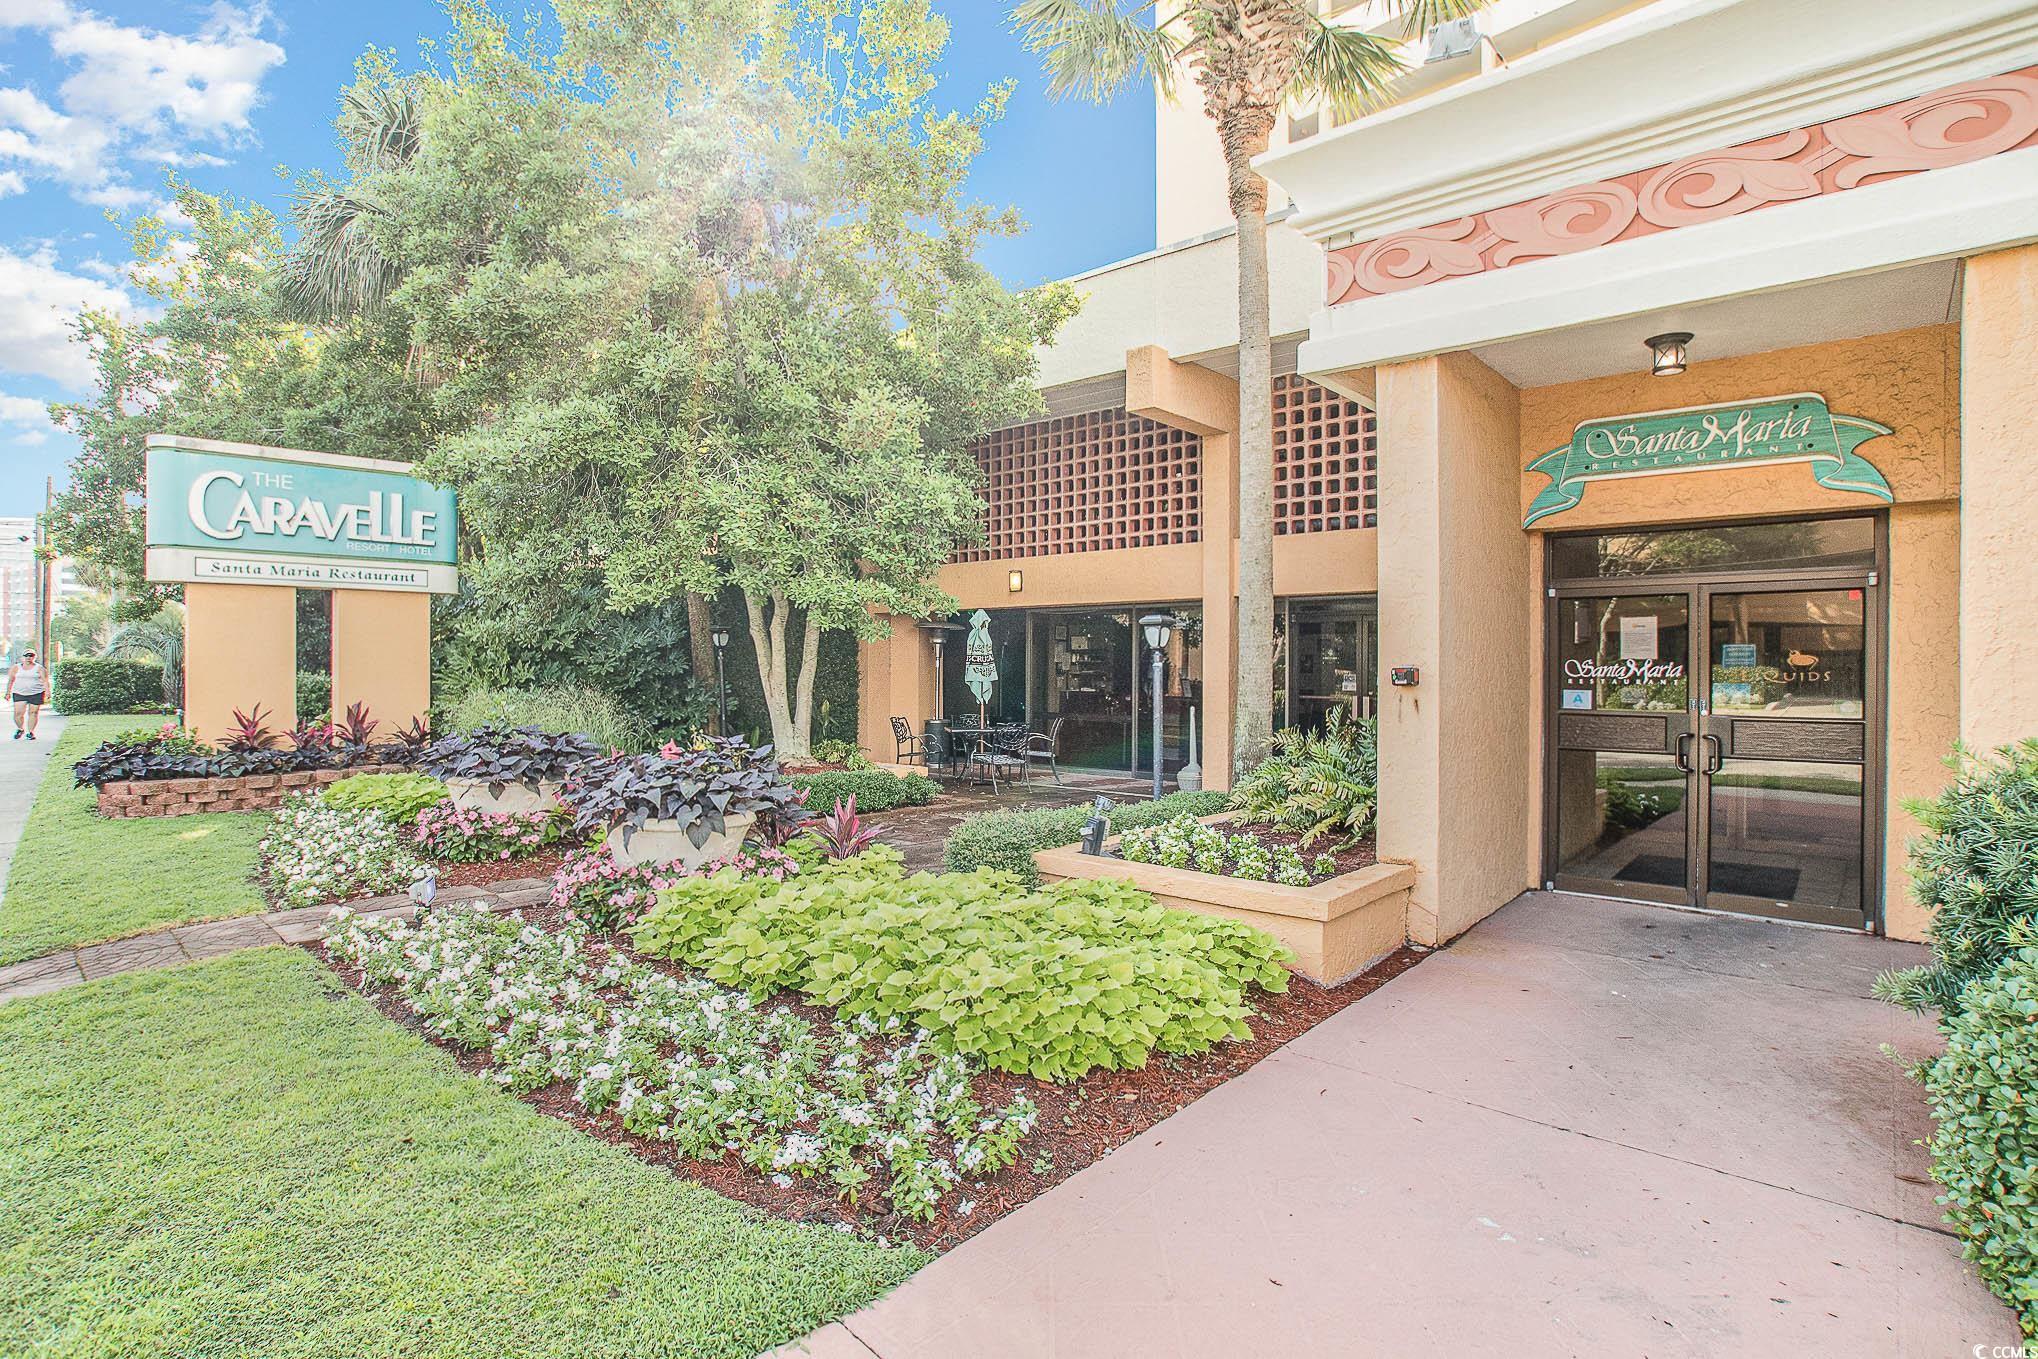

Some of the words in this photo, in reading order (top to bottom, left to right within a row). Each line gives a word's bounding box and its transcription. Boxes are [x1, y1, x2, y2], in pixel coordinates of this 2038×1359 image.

[1585, 424, 1697, 460] Santa
[1692, 411, 1813, 456] Maria
[1591, 442, 1804, 470] RESTAURANT
[252, 471, 294, 489] THE
[346, 541, 390, 553] RESORT
[399, 545, 433, 556] HOTEL
[210, 561, 262, 576] Santa
[269, 565, 321, 579] Maria
[329, 568, 416, 583] Restaurant
[1564, 658, 1627, 680] Santa
[1621, 658, 1684, 685] Maria
[1567, 678, 1682, 686] RESTAURANT
